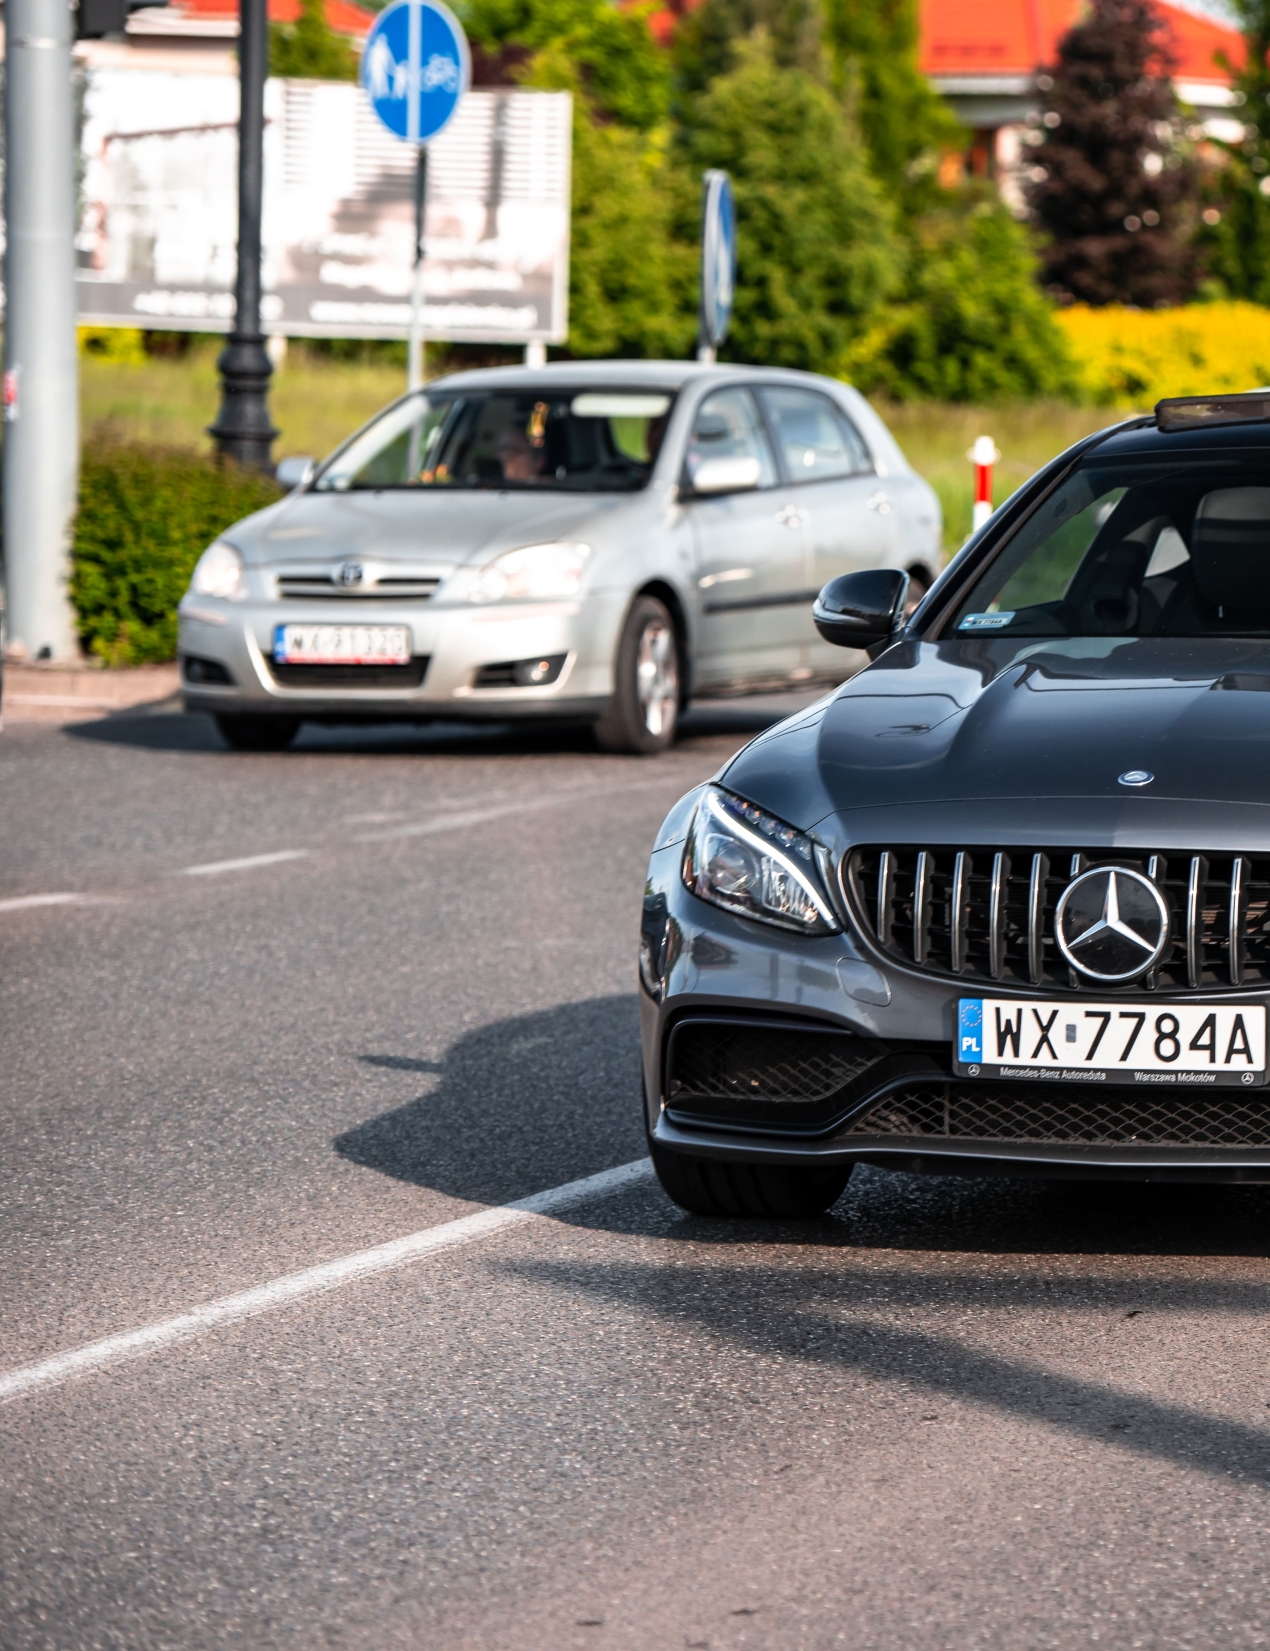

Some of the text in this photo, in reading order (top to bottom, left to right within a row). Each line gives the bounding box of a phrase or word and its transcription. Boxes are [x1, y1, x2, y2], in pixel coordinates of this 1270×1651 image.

[961, 1036, 981, 1052] PL
[995, 1006, 1254, 1065] WX 7784A
[999, 1066, 1217, 1083] Mercedes-Benz Autoreduta Warszawa Mokotów
